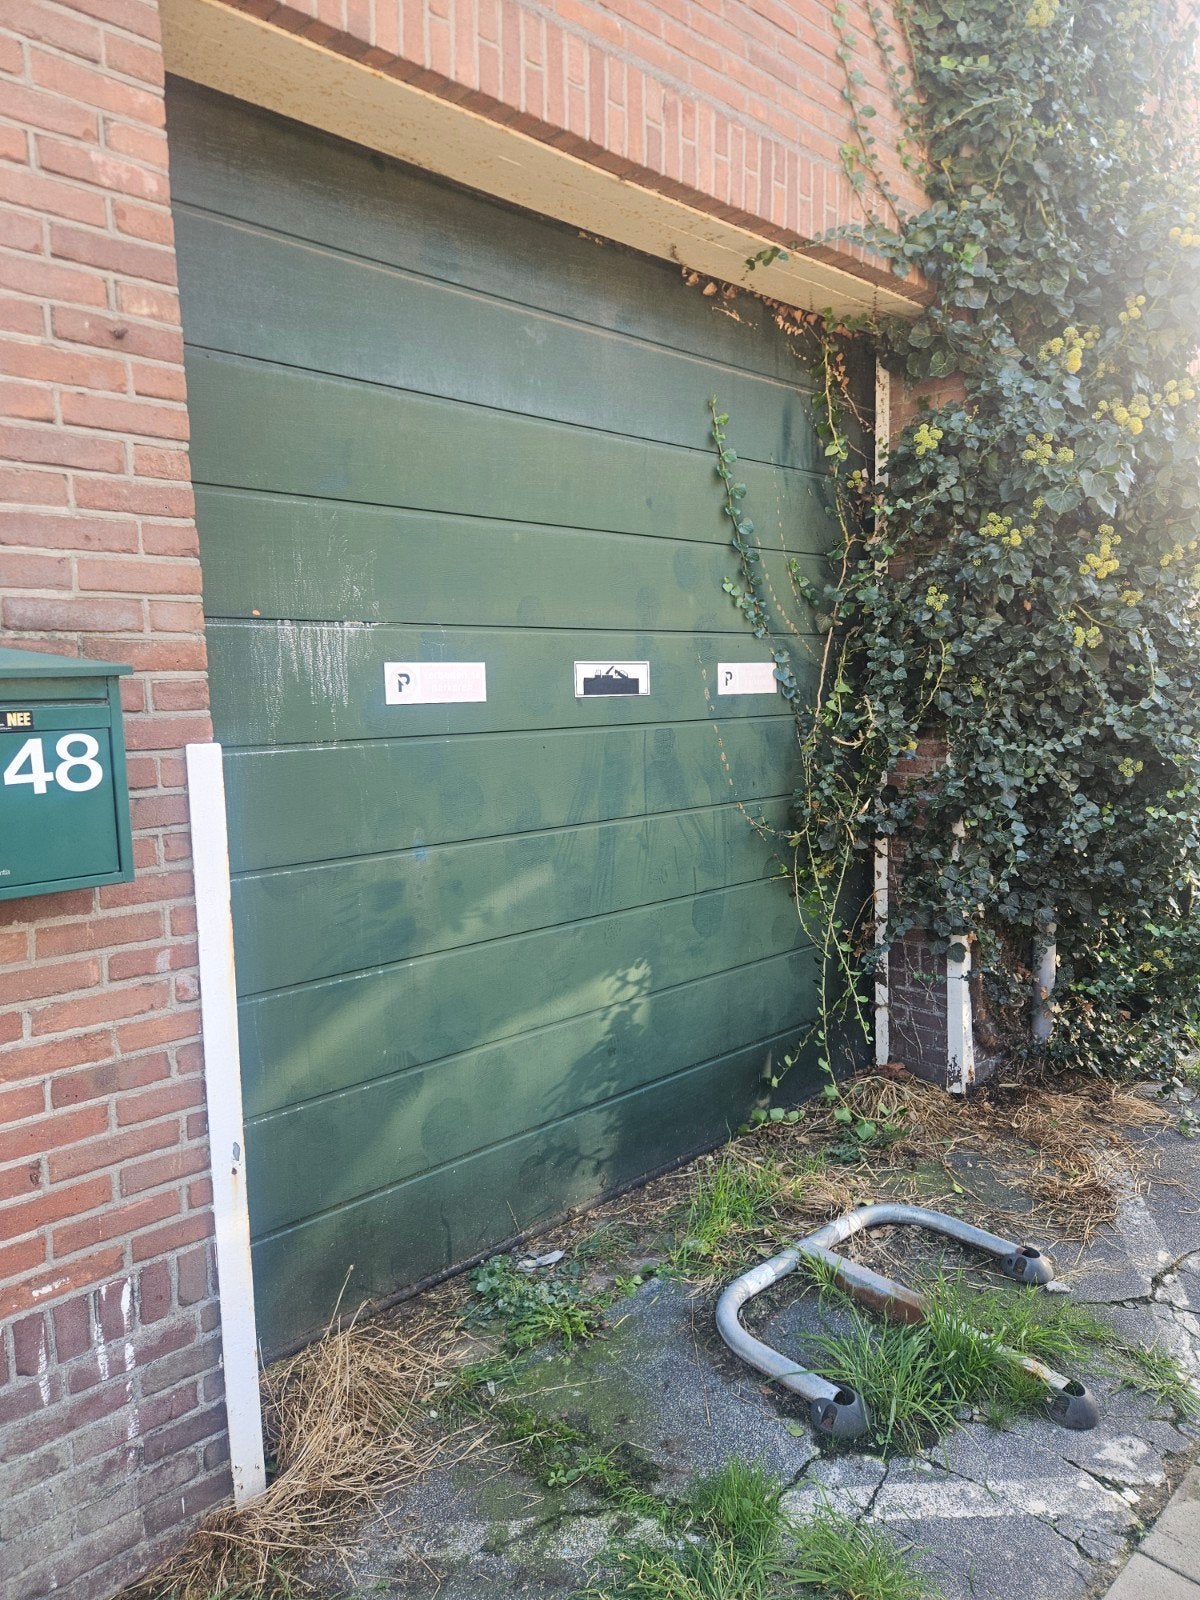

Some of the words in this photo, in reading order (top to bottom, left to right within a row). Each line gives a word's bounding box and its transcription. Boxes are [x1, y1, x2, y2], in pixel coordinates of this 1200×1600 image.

[397, 673, 411, 692] P
[725, 671, 733, 687] P
[6, 712, 31, 726] NEE
[3, 733, 103, 794] 48
